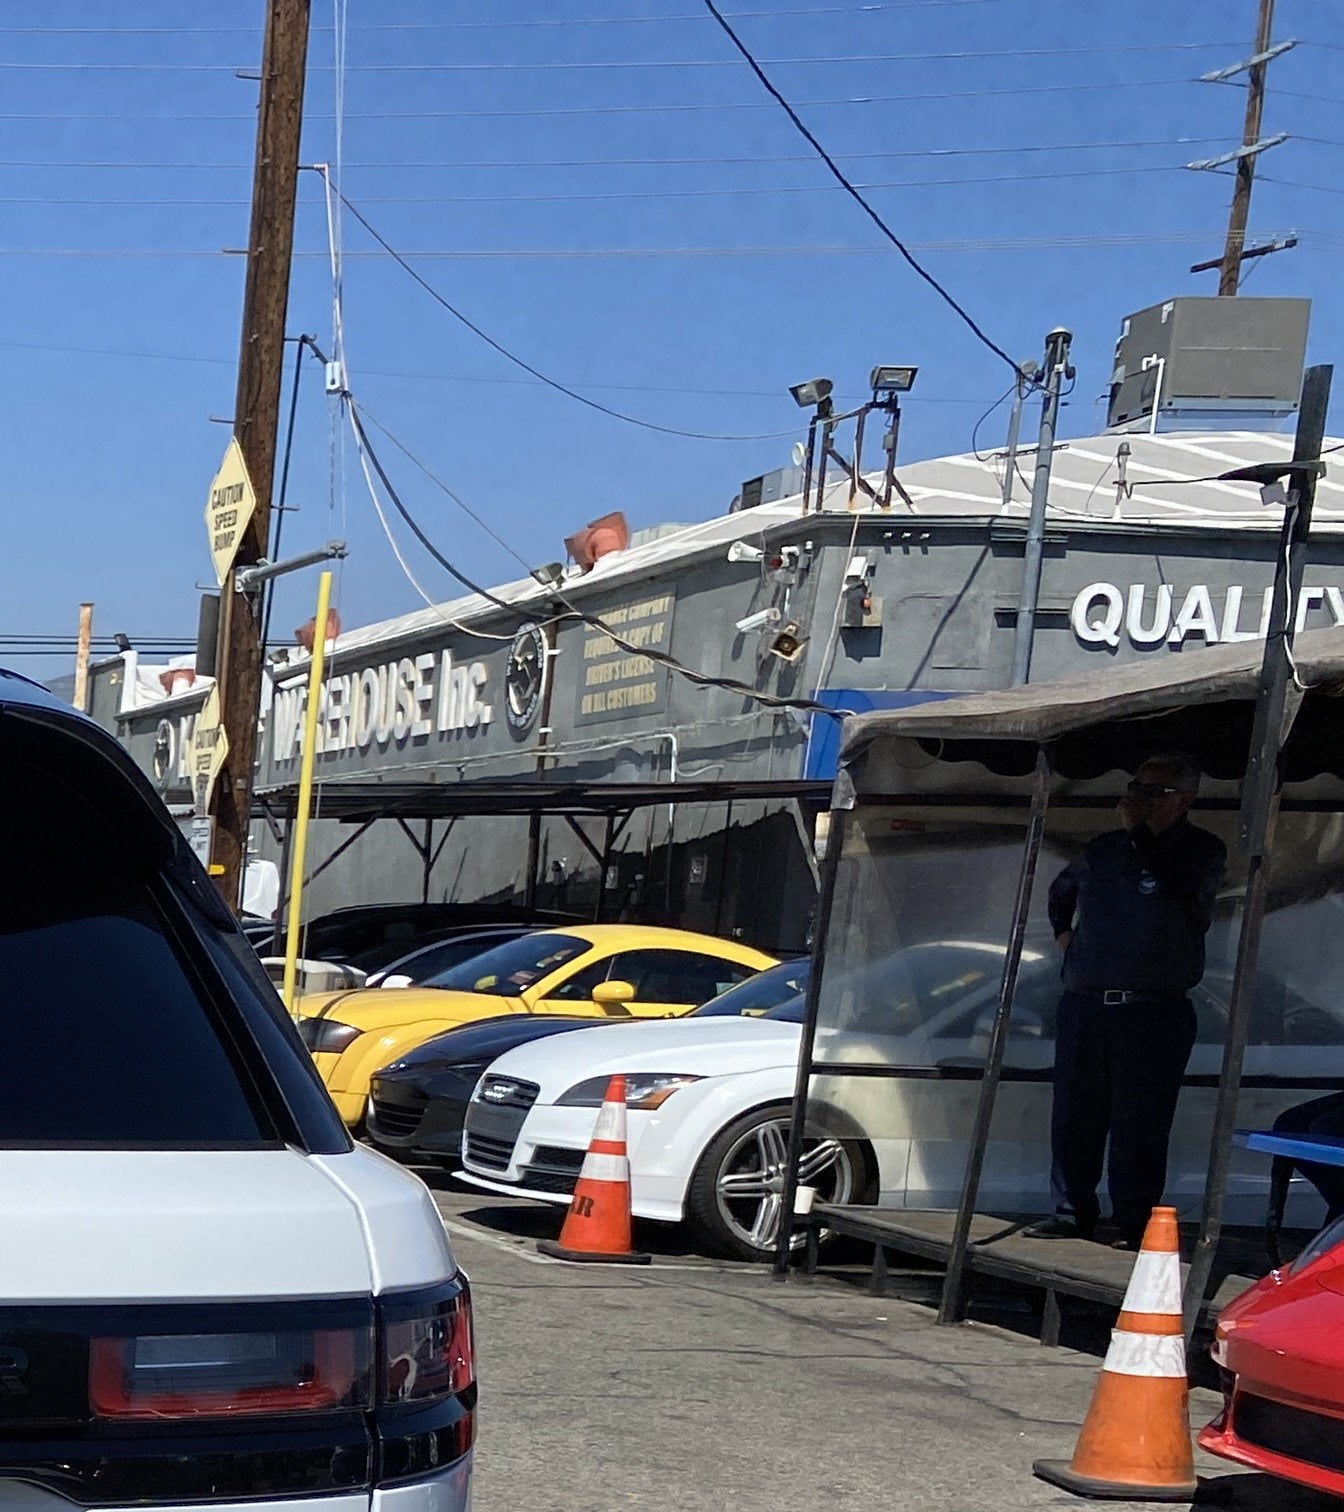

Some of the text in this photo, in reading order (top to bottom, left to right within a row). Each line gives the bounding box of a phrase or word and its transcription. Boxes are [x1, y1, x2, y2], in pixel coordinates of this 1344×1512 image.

[212, 482, 244, 510] CAUTION
[214, 509, 238, 531] SPEED
[214, 530, 235, 552] BUMP
[437, 648, 492, 732] Inc.
